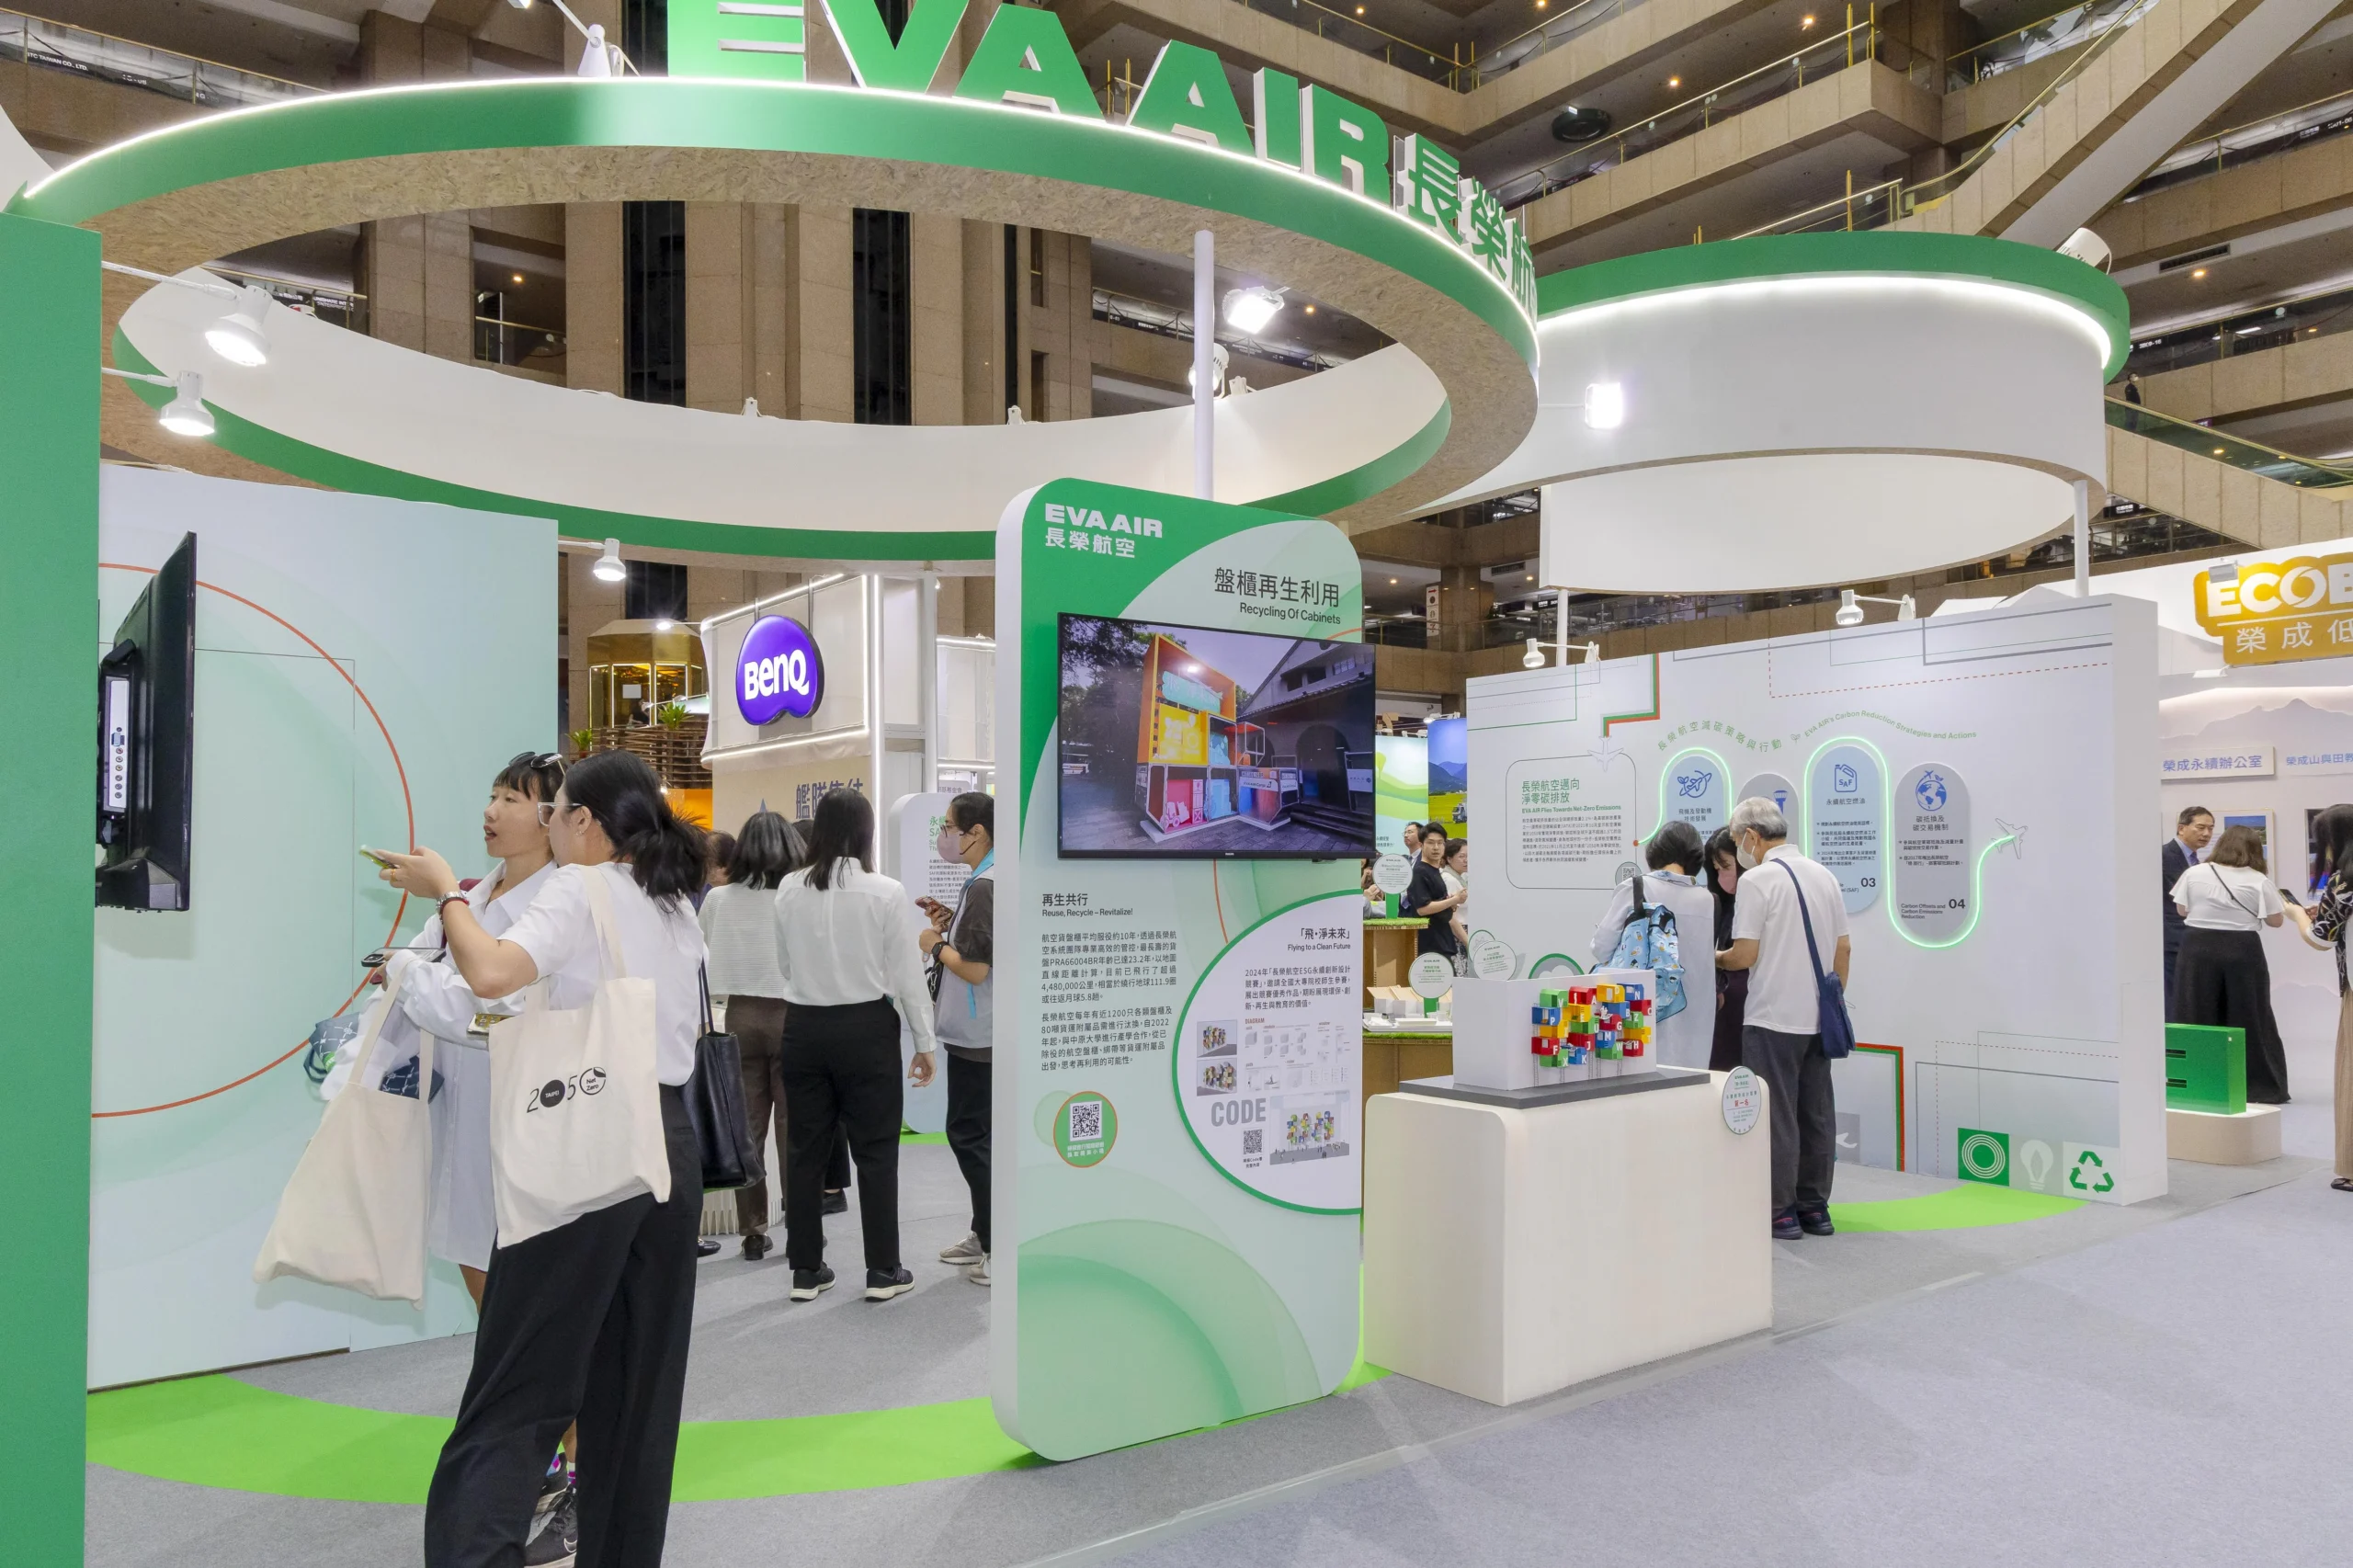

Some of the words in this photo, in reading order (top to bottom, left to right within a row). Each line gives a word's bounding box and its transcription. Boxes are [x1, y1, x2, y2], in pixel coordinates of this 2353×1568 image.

[667, 0, 1106, 121] EVA
[1127, 40, 1392, 207] AIR
[1407, 133, 1538, 324] 長榮航
[1045, 503, 1108, 530] EVA
[1110, 514, 1163, 539] AIR
[1045, 528, 1135, 558] 長榮航空
[1214, 567, 1339, 608] 盤櫃再生利用
[1240, 602, 1286, 619] Recycling
[1288, 608, 1299, 619] Of
[1301, 609, 1341, 625] Cabinets
[744, 649, 810, 700] BenQ
[1835, 710, 1859, 722] Carbon
[1860, 710, 1896, 728] Reduction
[1896, 722, 1931, 739] Strategies
[1948, 731, 1977, 740] Actions
[2163, 755, 2263, 772] 榮成永續辦公室
[1521, 778, 1580, 793] 長榮航空邁向
[1838, 778, 1852, 788] SAF
[1521, 791, 1570, 805] 淨零碳排放
[1860, 878, 1876, 888] 03
[1041, 892, 1088, 906] 再生共行
[1949, 899, 1966, 909] 04
[1042, 909, 1066, 917] Reuse,
[1066, 909, 1094, 917] Recycle
[1099, 908, 1133, 916] Revitalize!
[1287, 943, 1305, 952] Flying
[1614, 986, 1620, 994] D
[1591, 995, 1597, 1005] A
[1634, 991, 1640, 1000] N
[1626, 1009, 1631, 1017] B
[1633, 1013, 1638, 1021] Z
[1550, 1017, 1555, 1025] P
[1616, 1022, 1622, 1030] G
[1594, 1023, 1599, 1033] U
[1604, 1031, 1611, 1040] M
[1553, 1045, 1558, 1055] F
[1586, 1041, 1591, 1050] J
[1617, 1043, 1623, 1051] W
[1633, 1040, 1639, 1050] H
[1563, 1057, 1568, 1066] X
[1581, 1055, 1587, 1064] K
[1211, 1097, 1267, 1127] CODE
